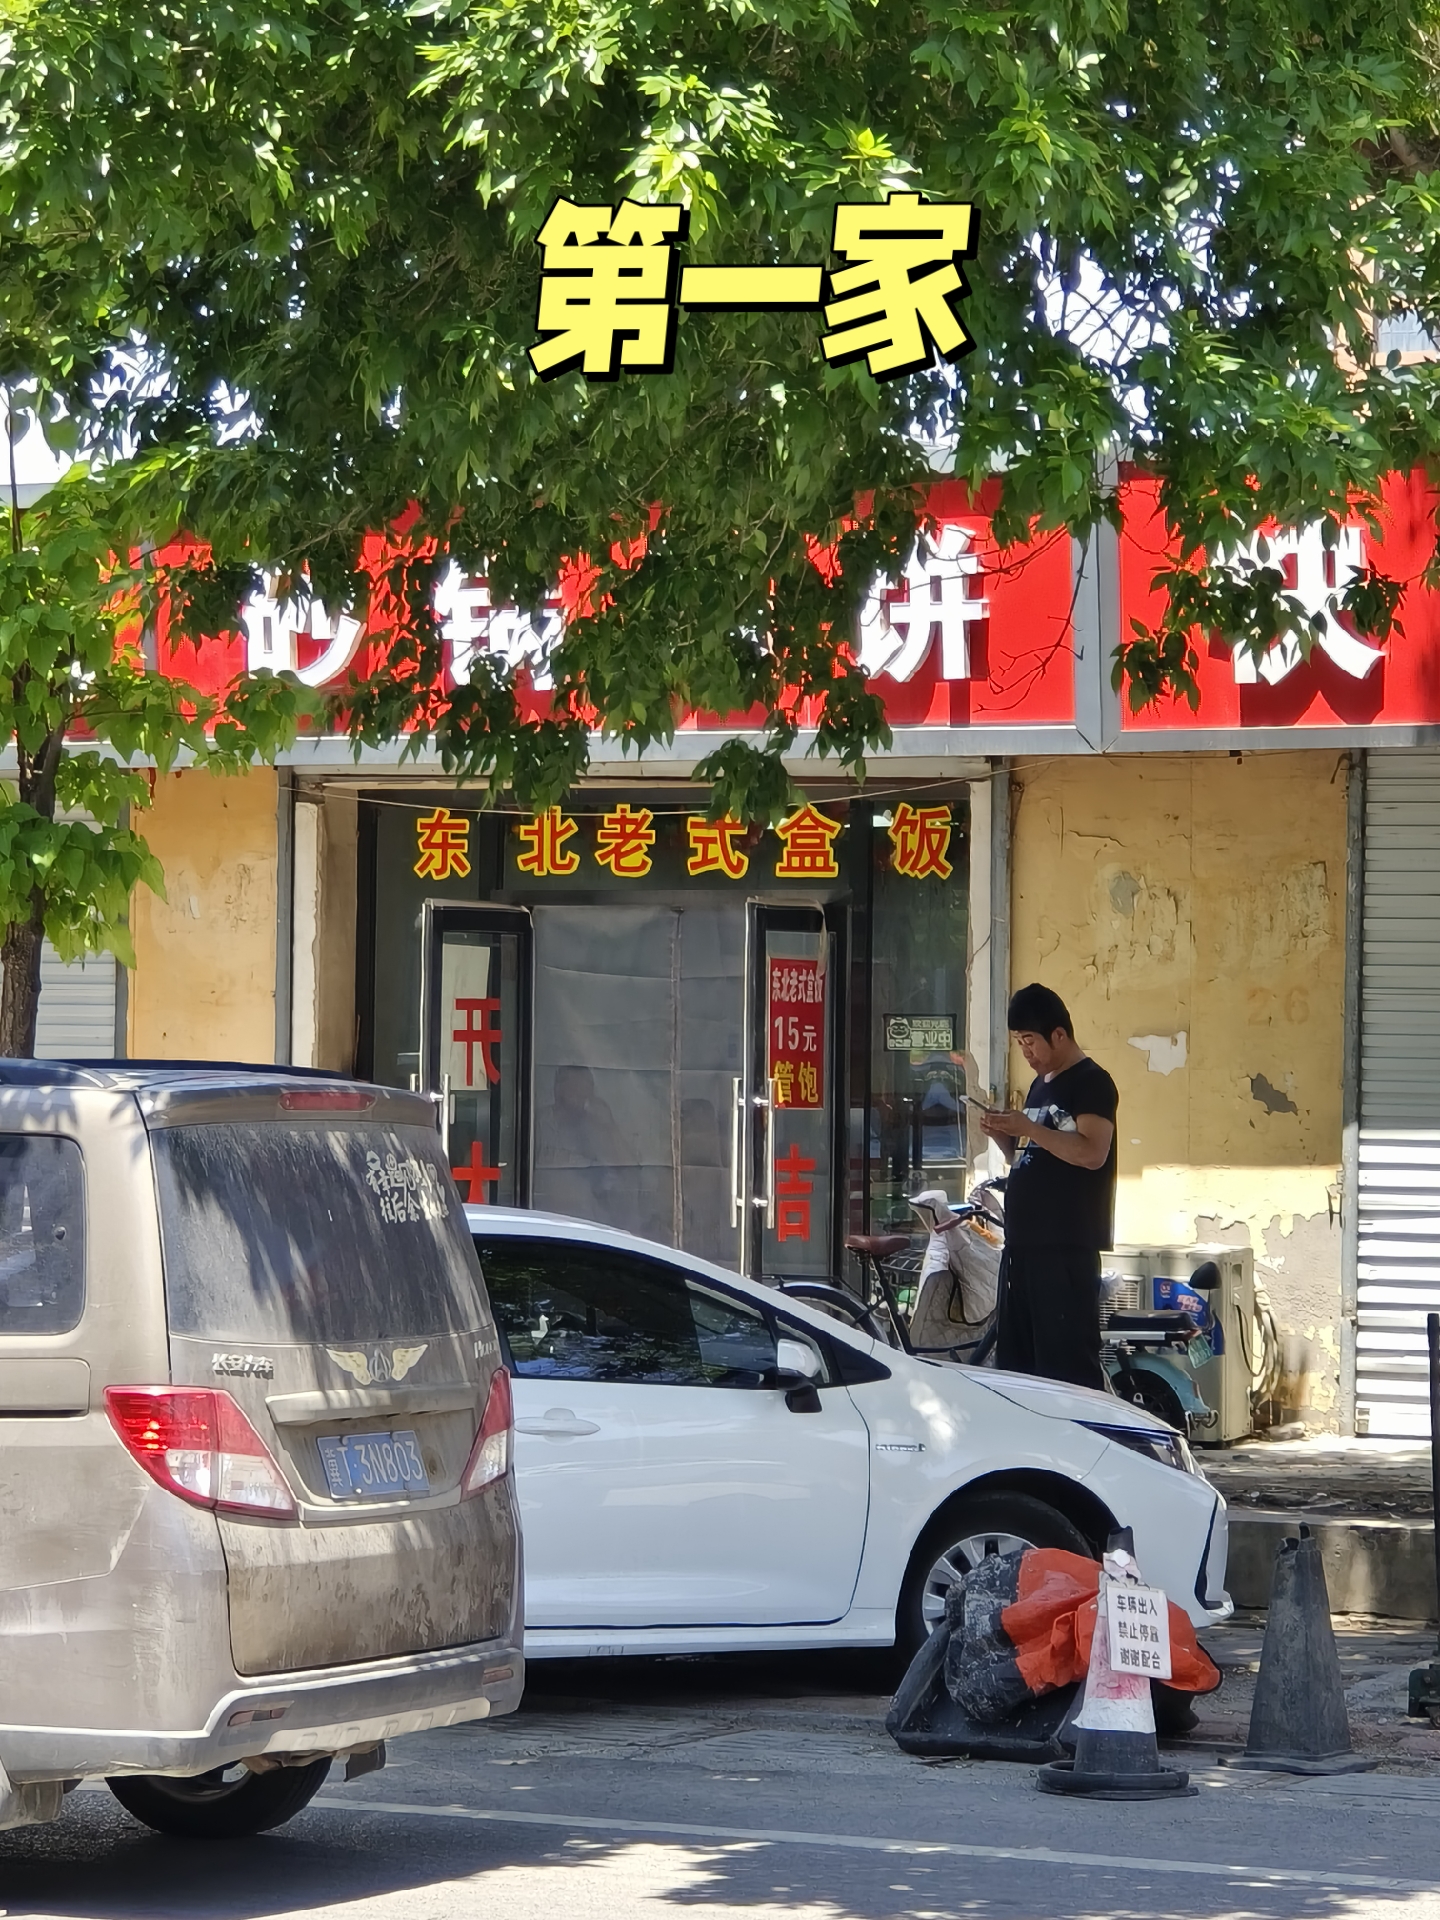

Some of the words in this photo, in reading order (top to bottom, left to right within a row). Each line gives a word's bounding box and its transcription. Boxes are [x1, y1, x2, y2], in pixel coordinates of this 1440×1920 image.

[414, 802, 955, 881] 东北老式盒饭
[774, 1015, 817, 1052] 15元
[773, 1060, 819, 1103] 管饱
[774, 1143, 816, 1242] 吉
[211, 1352, 275, 1377] 长安汽车
[1116, 1594, 1158, 1616] 车辆出入
[1120, 1647, 1161, 1670] 谢谢配合
